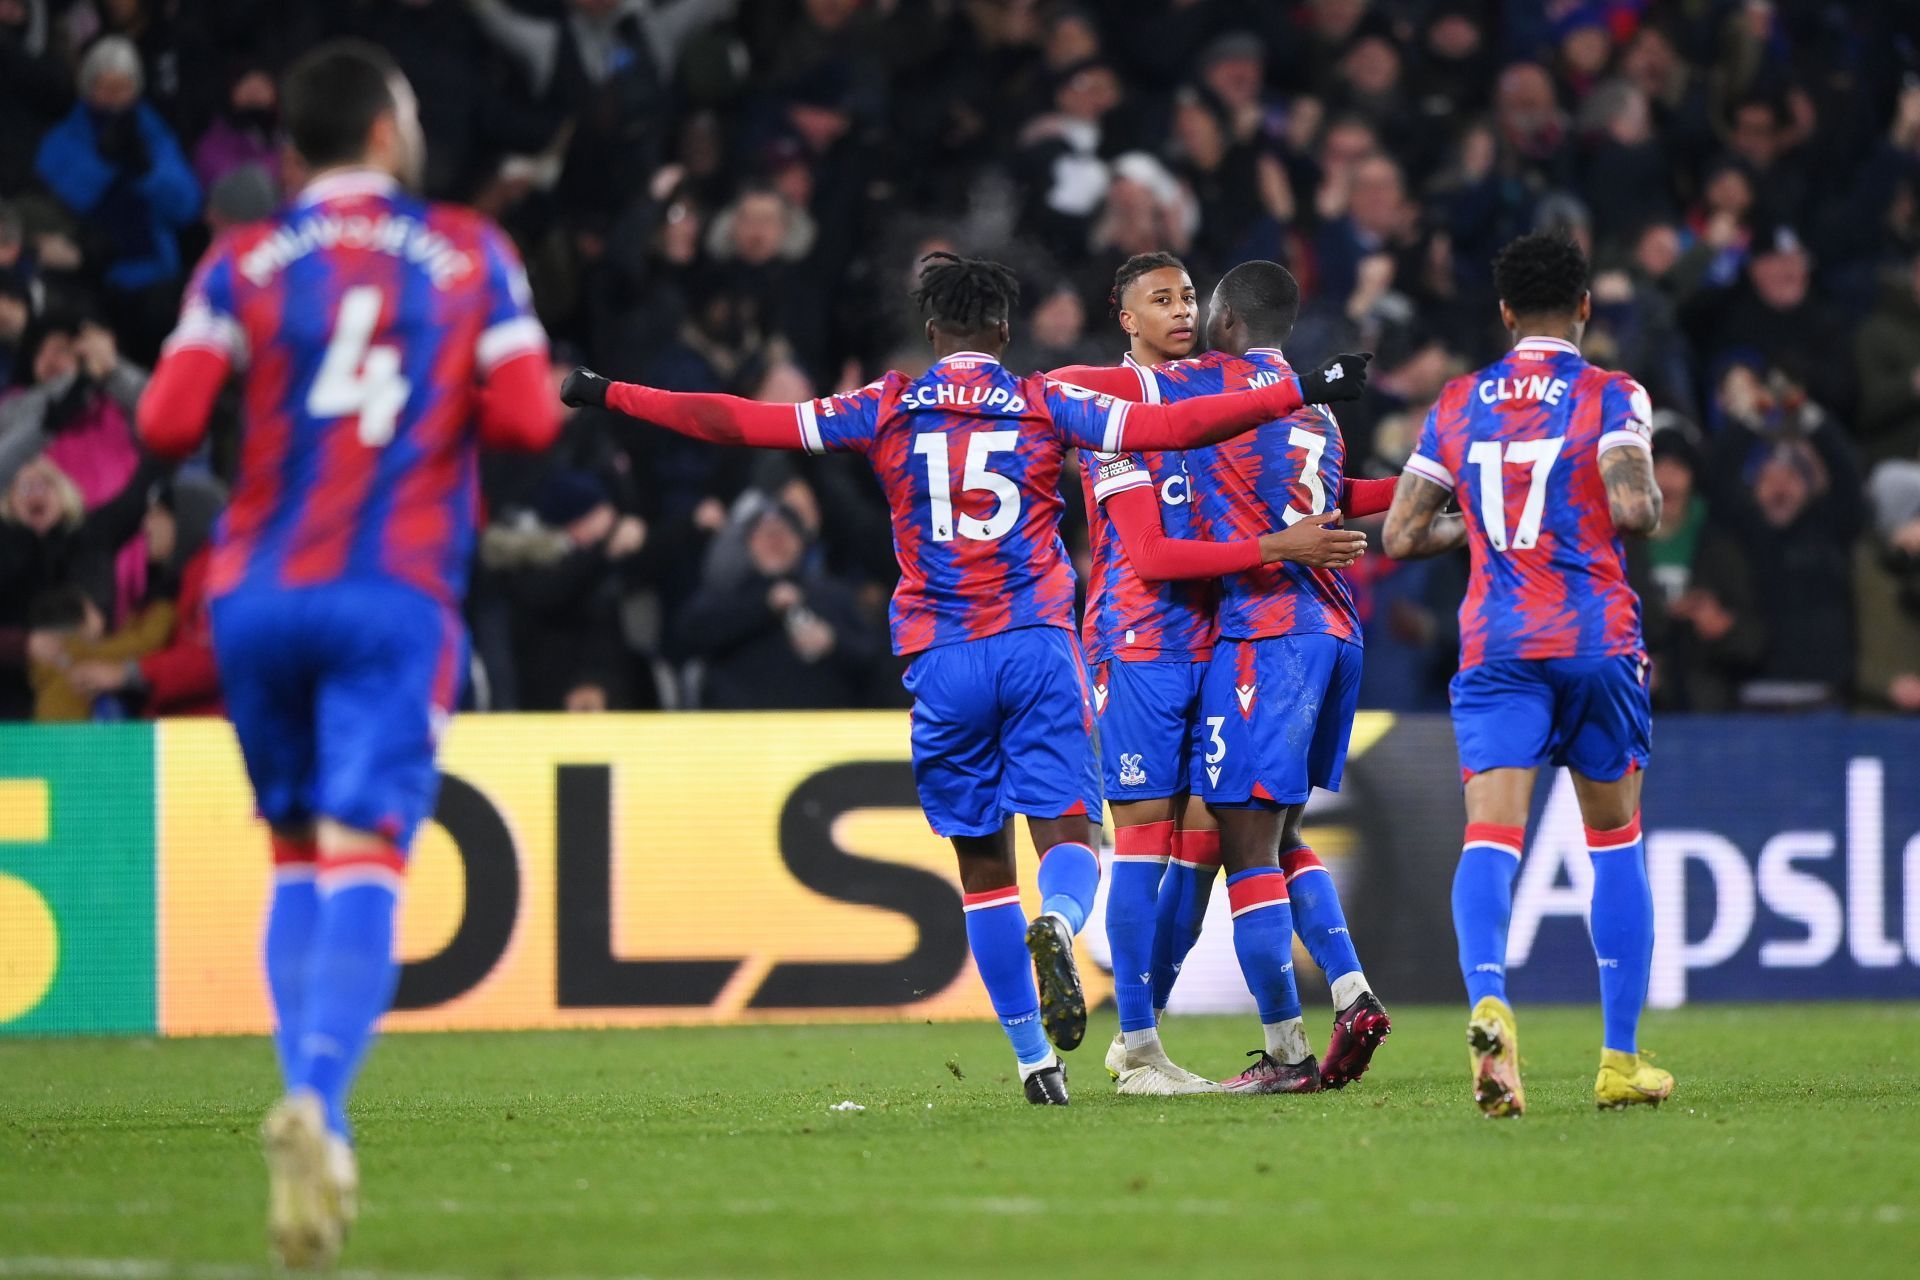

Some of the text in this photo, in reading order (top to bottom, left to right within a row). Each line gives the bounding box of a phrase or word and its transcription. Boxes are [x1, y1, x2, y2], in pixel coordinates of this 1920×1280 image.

[306, 286, 413, 447] 4
[901, 383, 1025, 413] SCHLUPP
[1478, 374, 1569, 406] CLYNE
[913, 430, 1022, 542] 15
[1281, 427, 1327, 527] 3
[1467, 436, 1565, 552] 17
[1205, 717, 1226, 763] 3
[1506, 757, 1920, 1008] Apsl
[1008, 1014, 1034, 1026] CPFC
